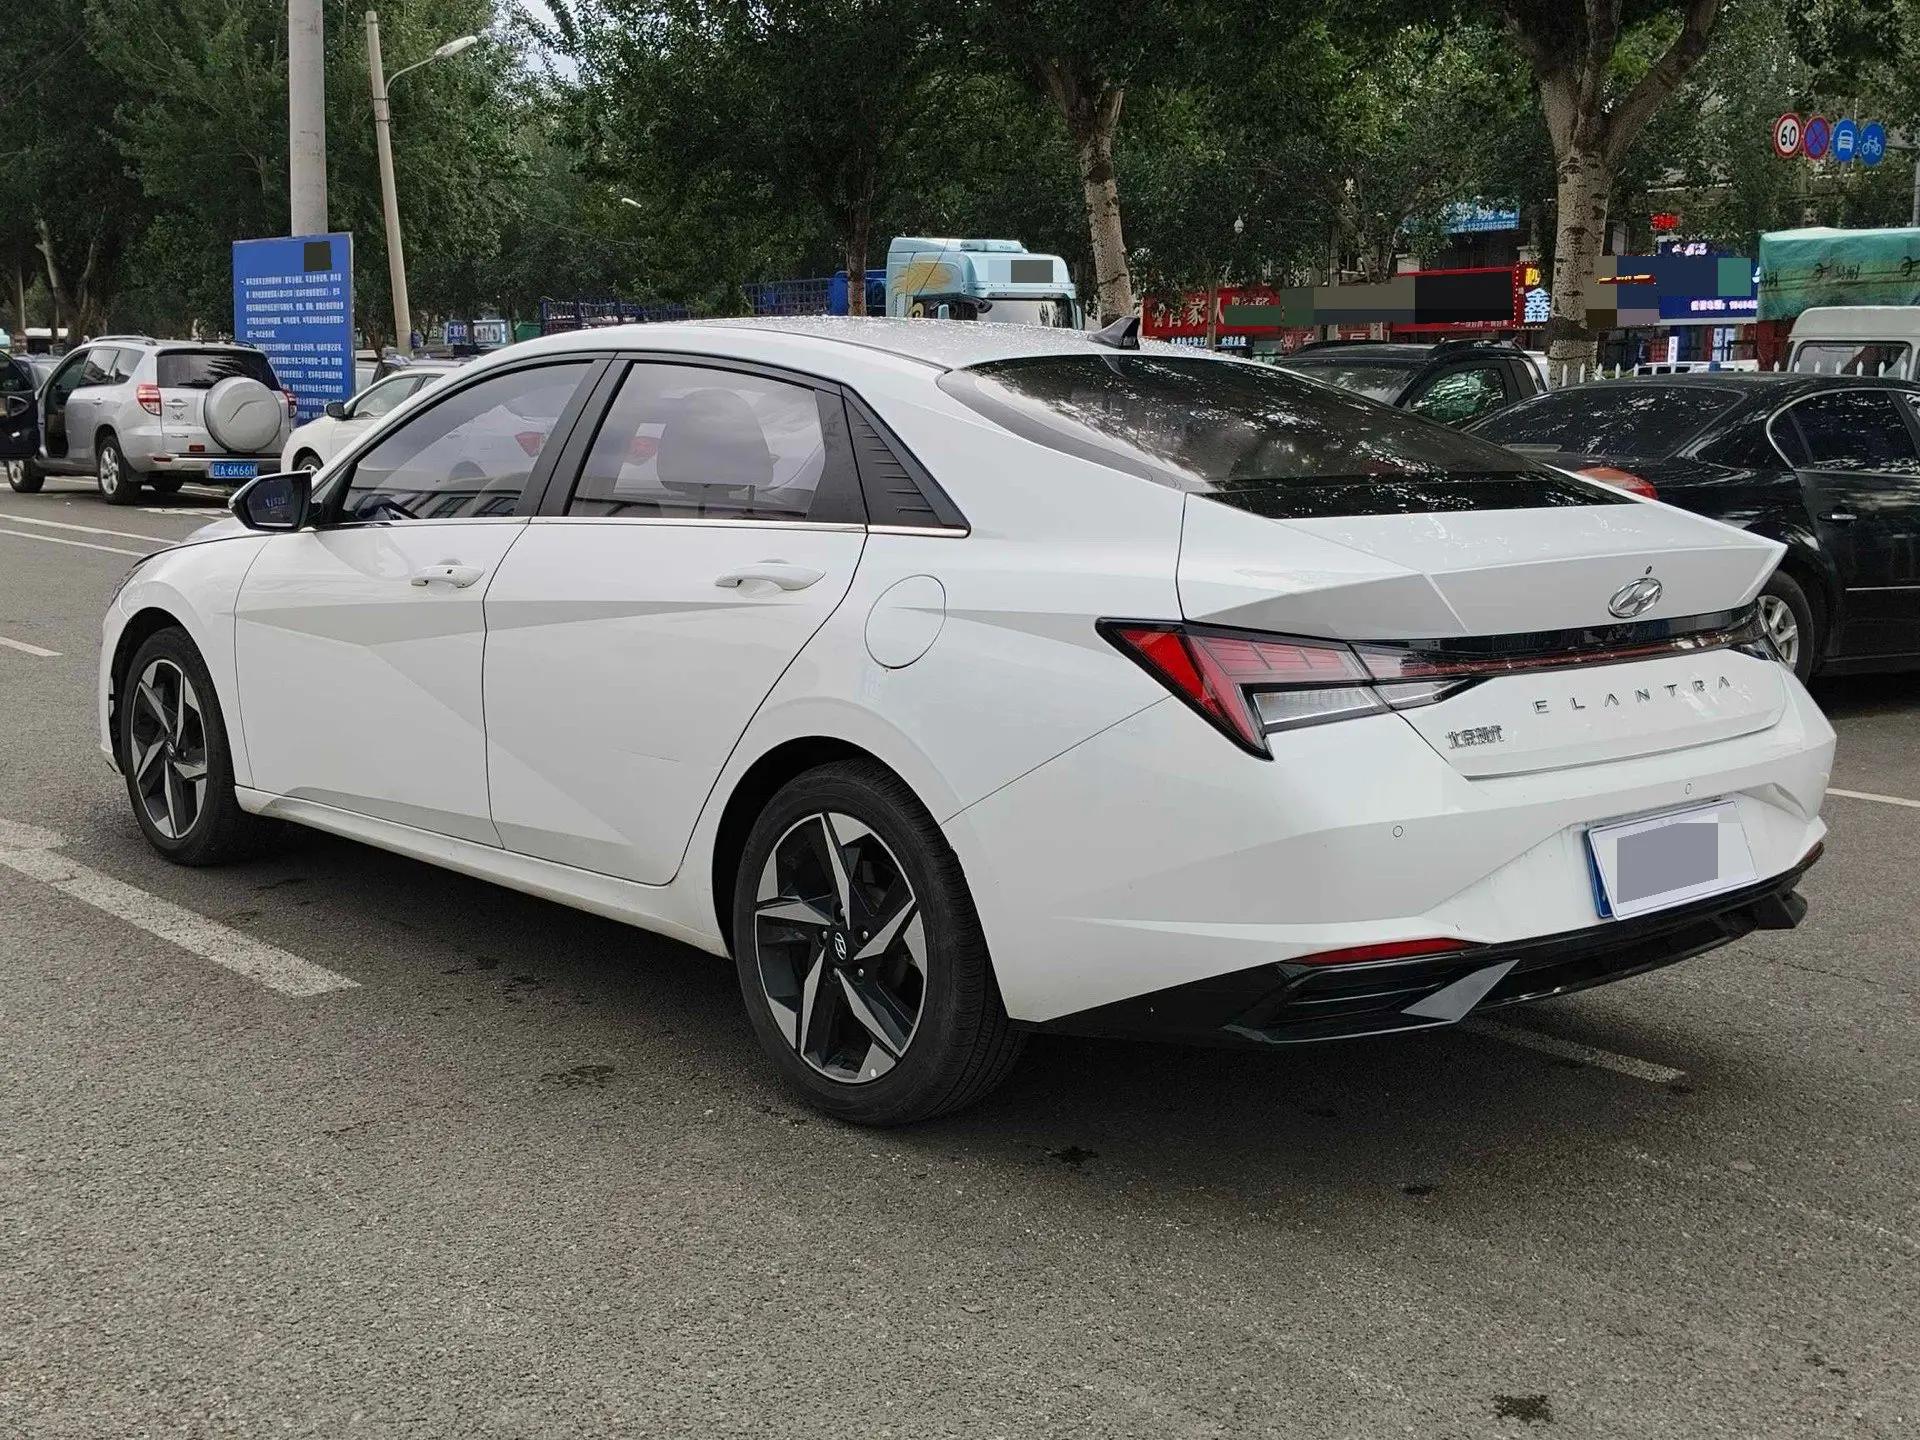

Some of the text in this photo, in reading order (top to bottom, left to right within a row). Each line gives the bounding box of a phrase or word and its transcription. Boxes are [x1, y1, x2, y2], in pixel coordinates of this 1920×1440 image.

[1781, 125, 1797, 146] 60
[1524, 287, 1551, 323] 鑫
[1533, 676, 1732, 713] ELANTRA
